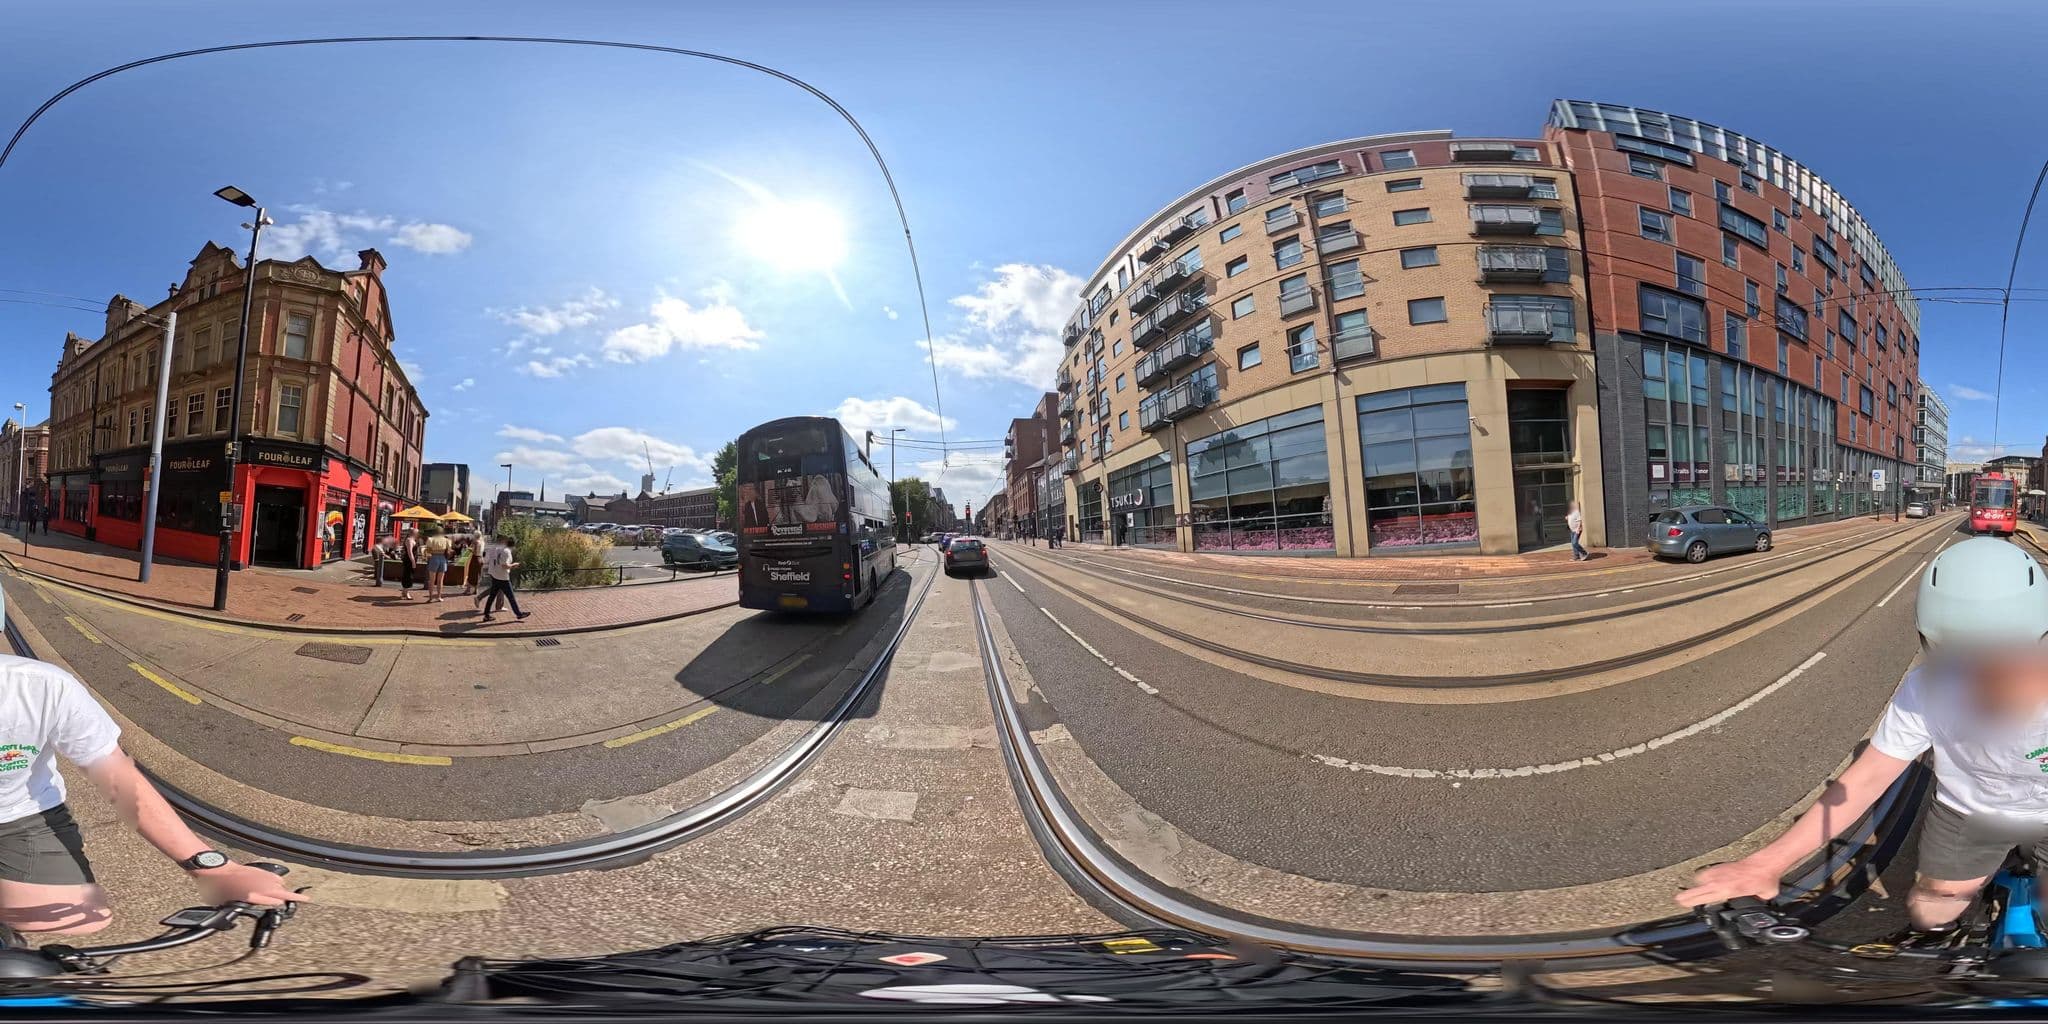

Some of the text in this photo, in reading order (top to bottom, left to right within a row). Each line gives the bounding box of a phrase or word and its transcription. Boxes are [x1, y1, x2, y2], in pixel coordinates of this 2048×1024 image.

[169, 459, 211, 469] FOUR LEAF
[258, 452, 313, 465] FOUR LEAF
[1110, 493, 1132, 508] TSUKI
[770, 571, 811, 581] Sheffield
